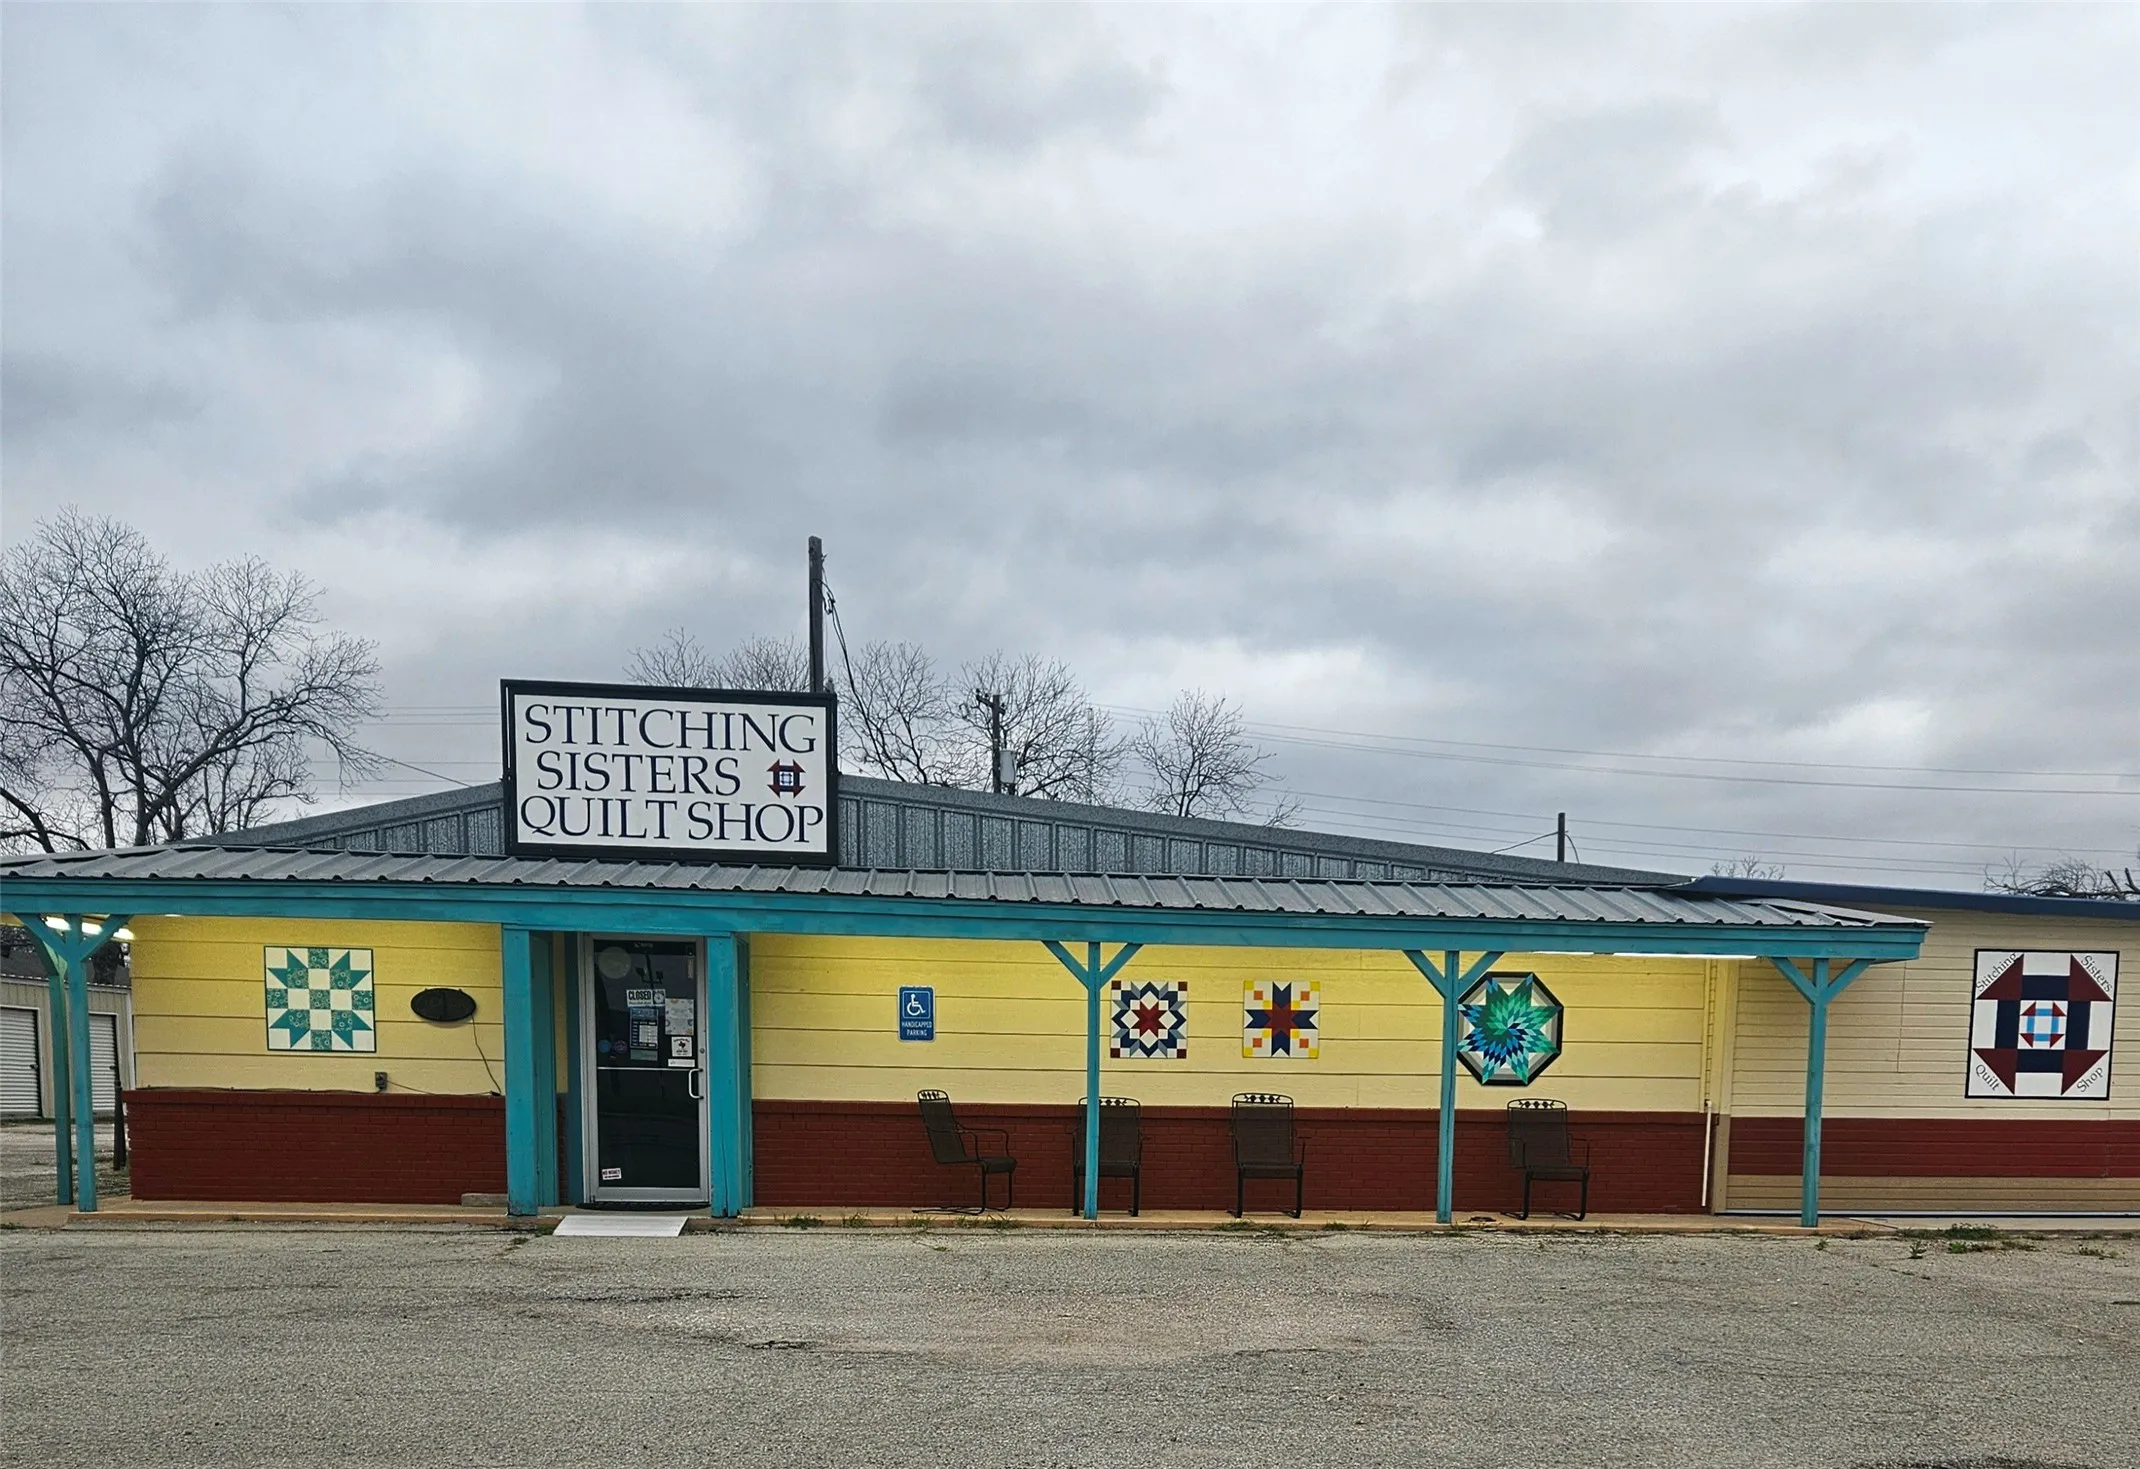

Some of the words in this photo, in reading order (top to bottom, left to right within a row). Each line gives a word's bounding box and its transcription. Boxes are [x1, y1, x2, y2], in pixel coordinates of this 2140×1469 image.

[525, 703, 816, 753] STITCHING
[537, 750, 741, 796] SISTERS
[520, 795, 677, 839] QUILT
[688, 801, 824, 842] SHOP
[1976, 952, 2017, 992] Stitching
[2080, 955, 2113, 992] Sisters
[628, 990, 652, 1001] CLOSED
[1975, 1064, 2001, 1091] Quilt
[2076, 1067, 2104, 1093] Shop
